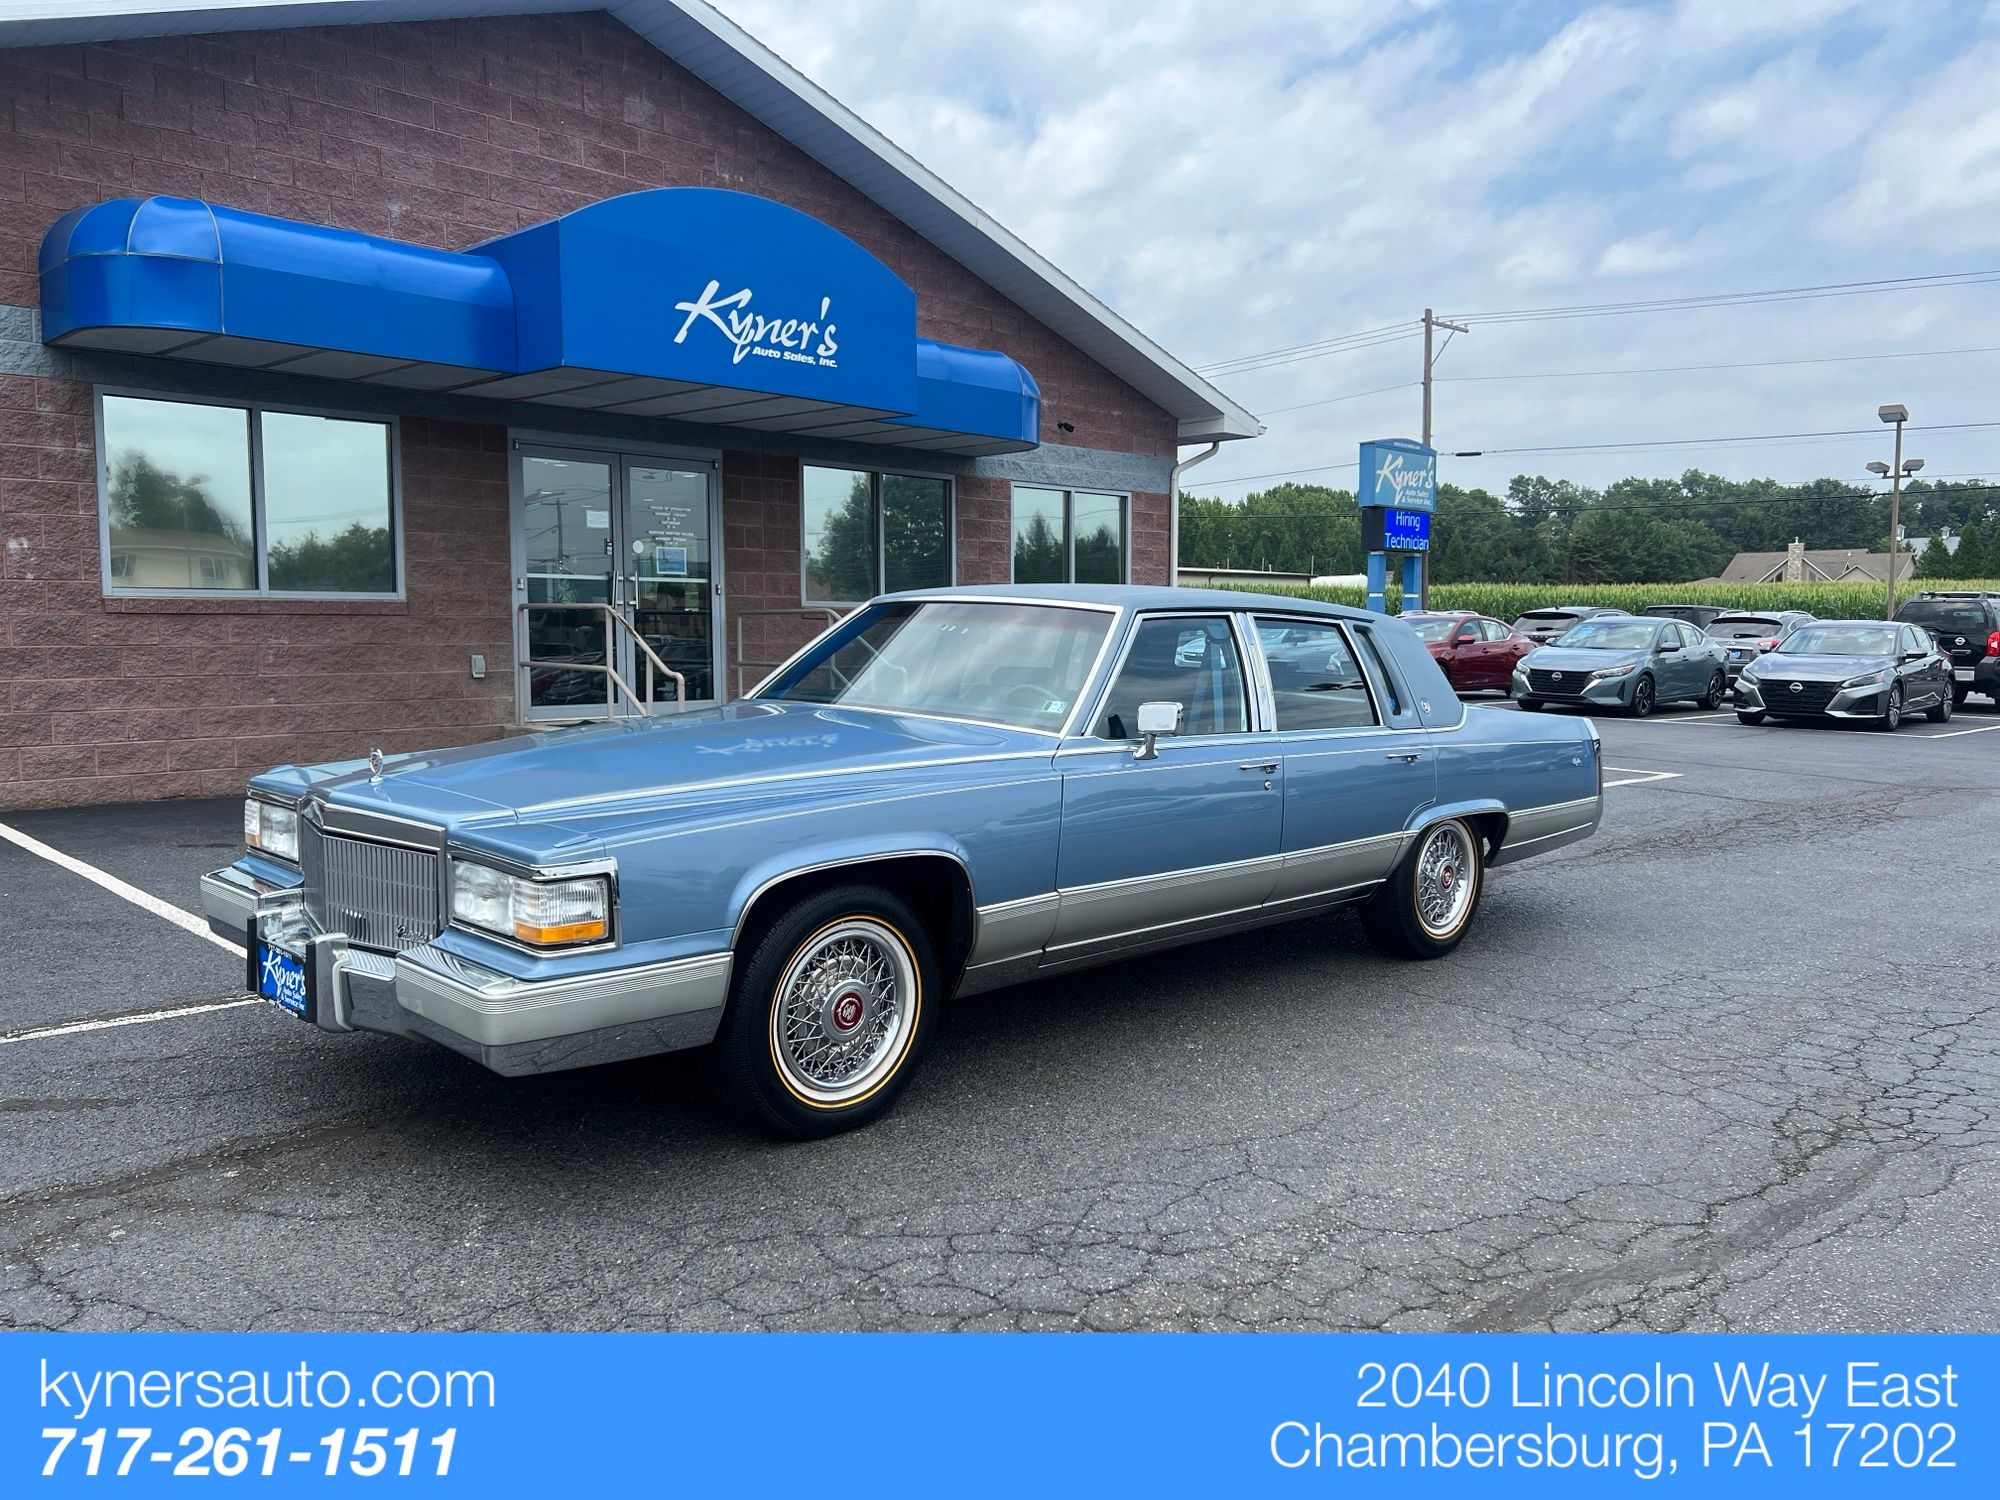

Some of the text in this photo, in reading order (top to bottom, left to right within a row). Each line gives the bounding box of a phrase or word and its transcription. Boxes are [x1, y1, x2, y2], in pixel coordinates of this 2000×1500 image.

[673, 279, 838, 364] Kyner's
[752, 346, 838, 368] Auto Sales, Inc.
[1375, 453, 1434, 505] Kyner's
[1406, 497, 1423, 505] Service
[1417, 490, 1429, 498] Sales
[1395, 511, 1420, 531] Hiring
[1385, 533, 1429, 550] Technician
[262, 949, 306, 996] Kyner's
